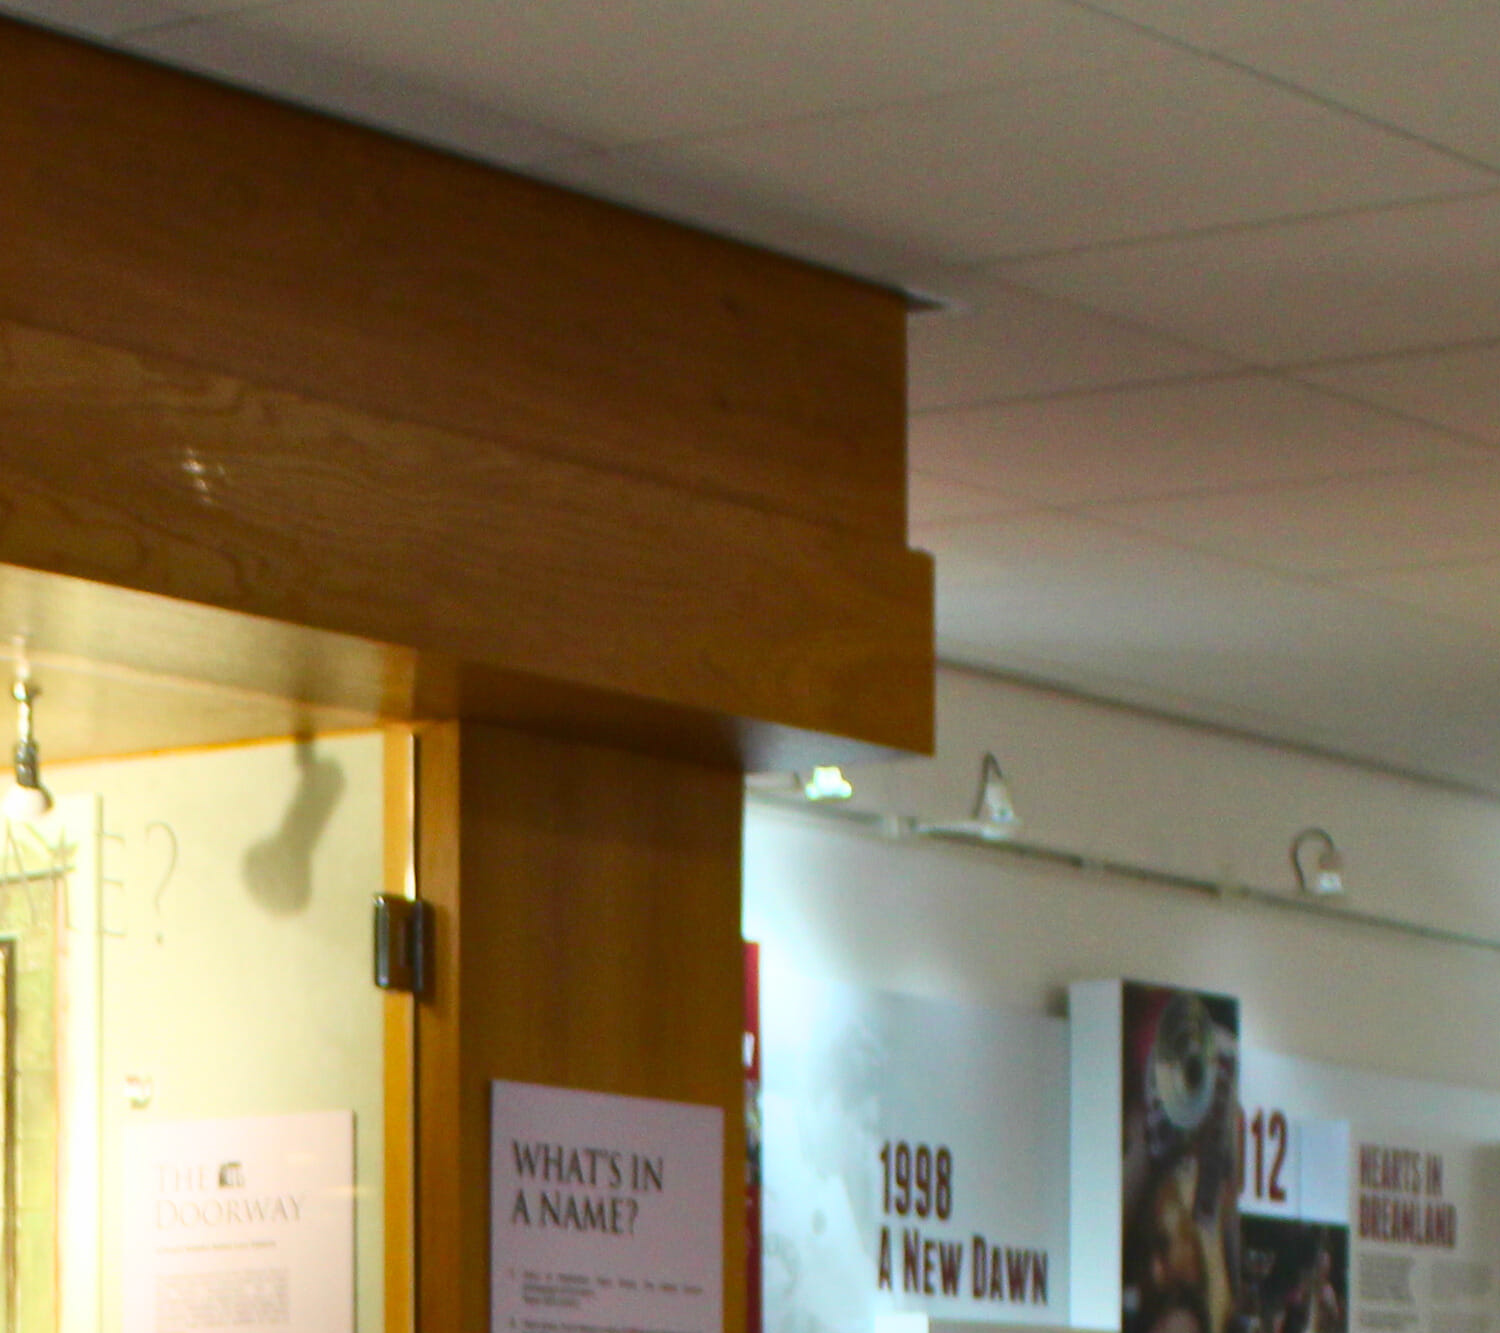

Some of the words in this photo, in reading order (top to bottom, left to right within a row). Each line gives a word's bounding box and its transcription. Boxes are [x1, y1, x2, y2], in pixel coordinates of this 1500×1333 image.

[511, 1138, 623, 1190] WHAT'S
[631, 1156, 665, 1194] IN
[879, 1139, 953, 1222] 1998
[155, 1193, 304, 1231] DOORWAY
[512, 1192, 532, 1227] A
[538, 1192, 640, 1236] NAME?
[877, 1225, 893, 1292] A
